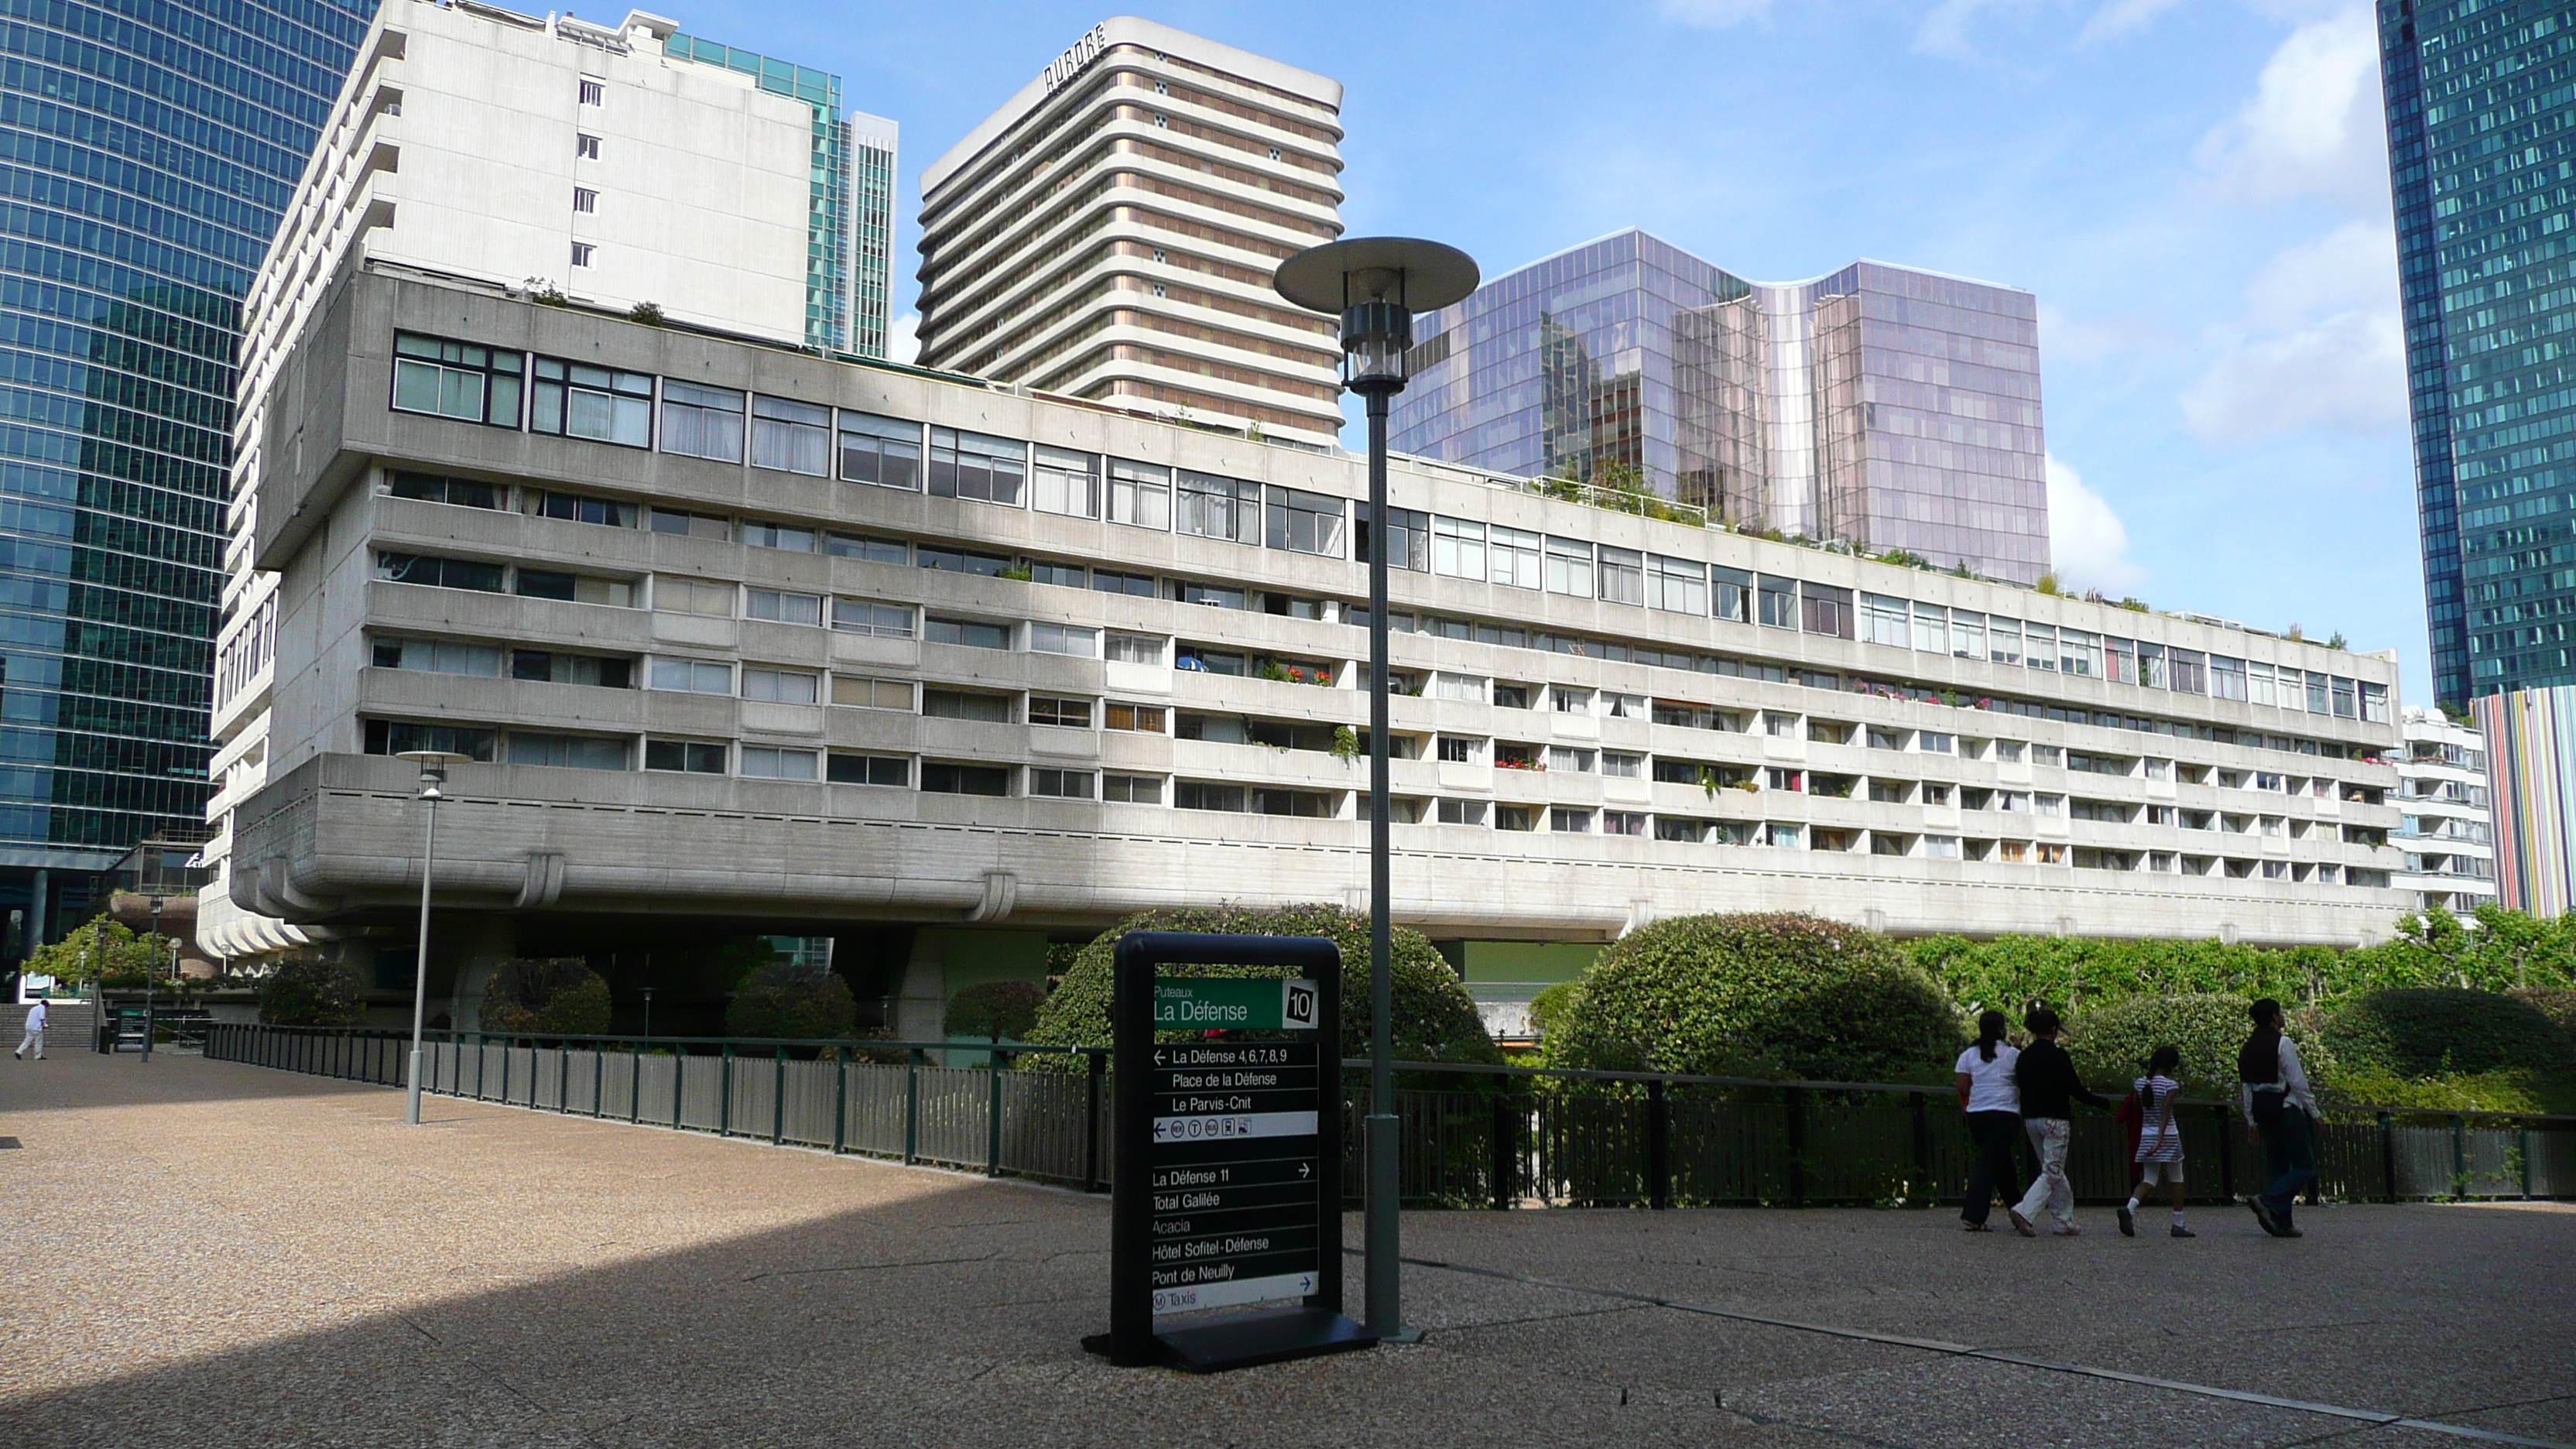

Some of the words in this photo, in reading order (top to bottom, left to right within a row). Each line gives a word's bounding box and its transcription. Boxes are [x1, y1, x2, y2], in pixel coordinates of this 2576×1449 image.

[1043, 23, 1105, 92] AURORE
[1154, 985, 1194, 999] Puteaux
[1154, 1001, 1175, 1021] La
[1181, 999, 1248, 1021] Défense
[1290, 992, 1310, 1017] 10
[1173, 1050, 1187, 1064] La
[1190, 1048, 1235, 1064] Défense
[1173, 1074, 1202, 1088] Place
[1205, 1074, 1220, 1087] de
[1222, 1073, 1232, 1086] la
[1235, 1071, 1276, 1086] Défense
[1173, 1098, 1187, 1112] Le
[1153, 1172, 1166, 1187] La
[1170, 1170, 1216, 1186] Défense
[1221, 1169, 1229, 1182] 11
[1153, 1196, 1179, 1211] Total
[1183, 1192, 1220, 1208] Galilée
[1153, 1218, 1190, 1235] Acacia
[1153, 1245, 1181, 1260] Hôtel
[1153, 1271, 1177, 1286] Pont
[1181, 1268, 1195, 1282] de
[1199, 1263, 1235, 1280] Neuilly
[1168, 1290, 1197, 1307] Taxis
